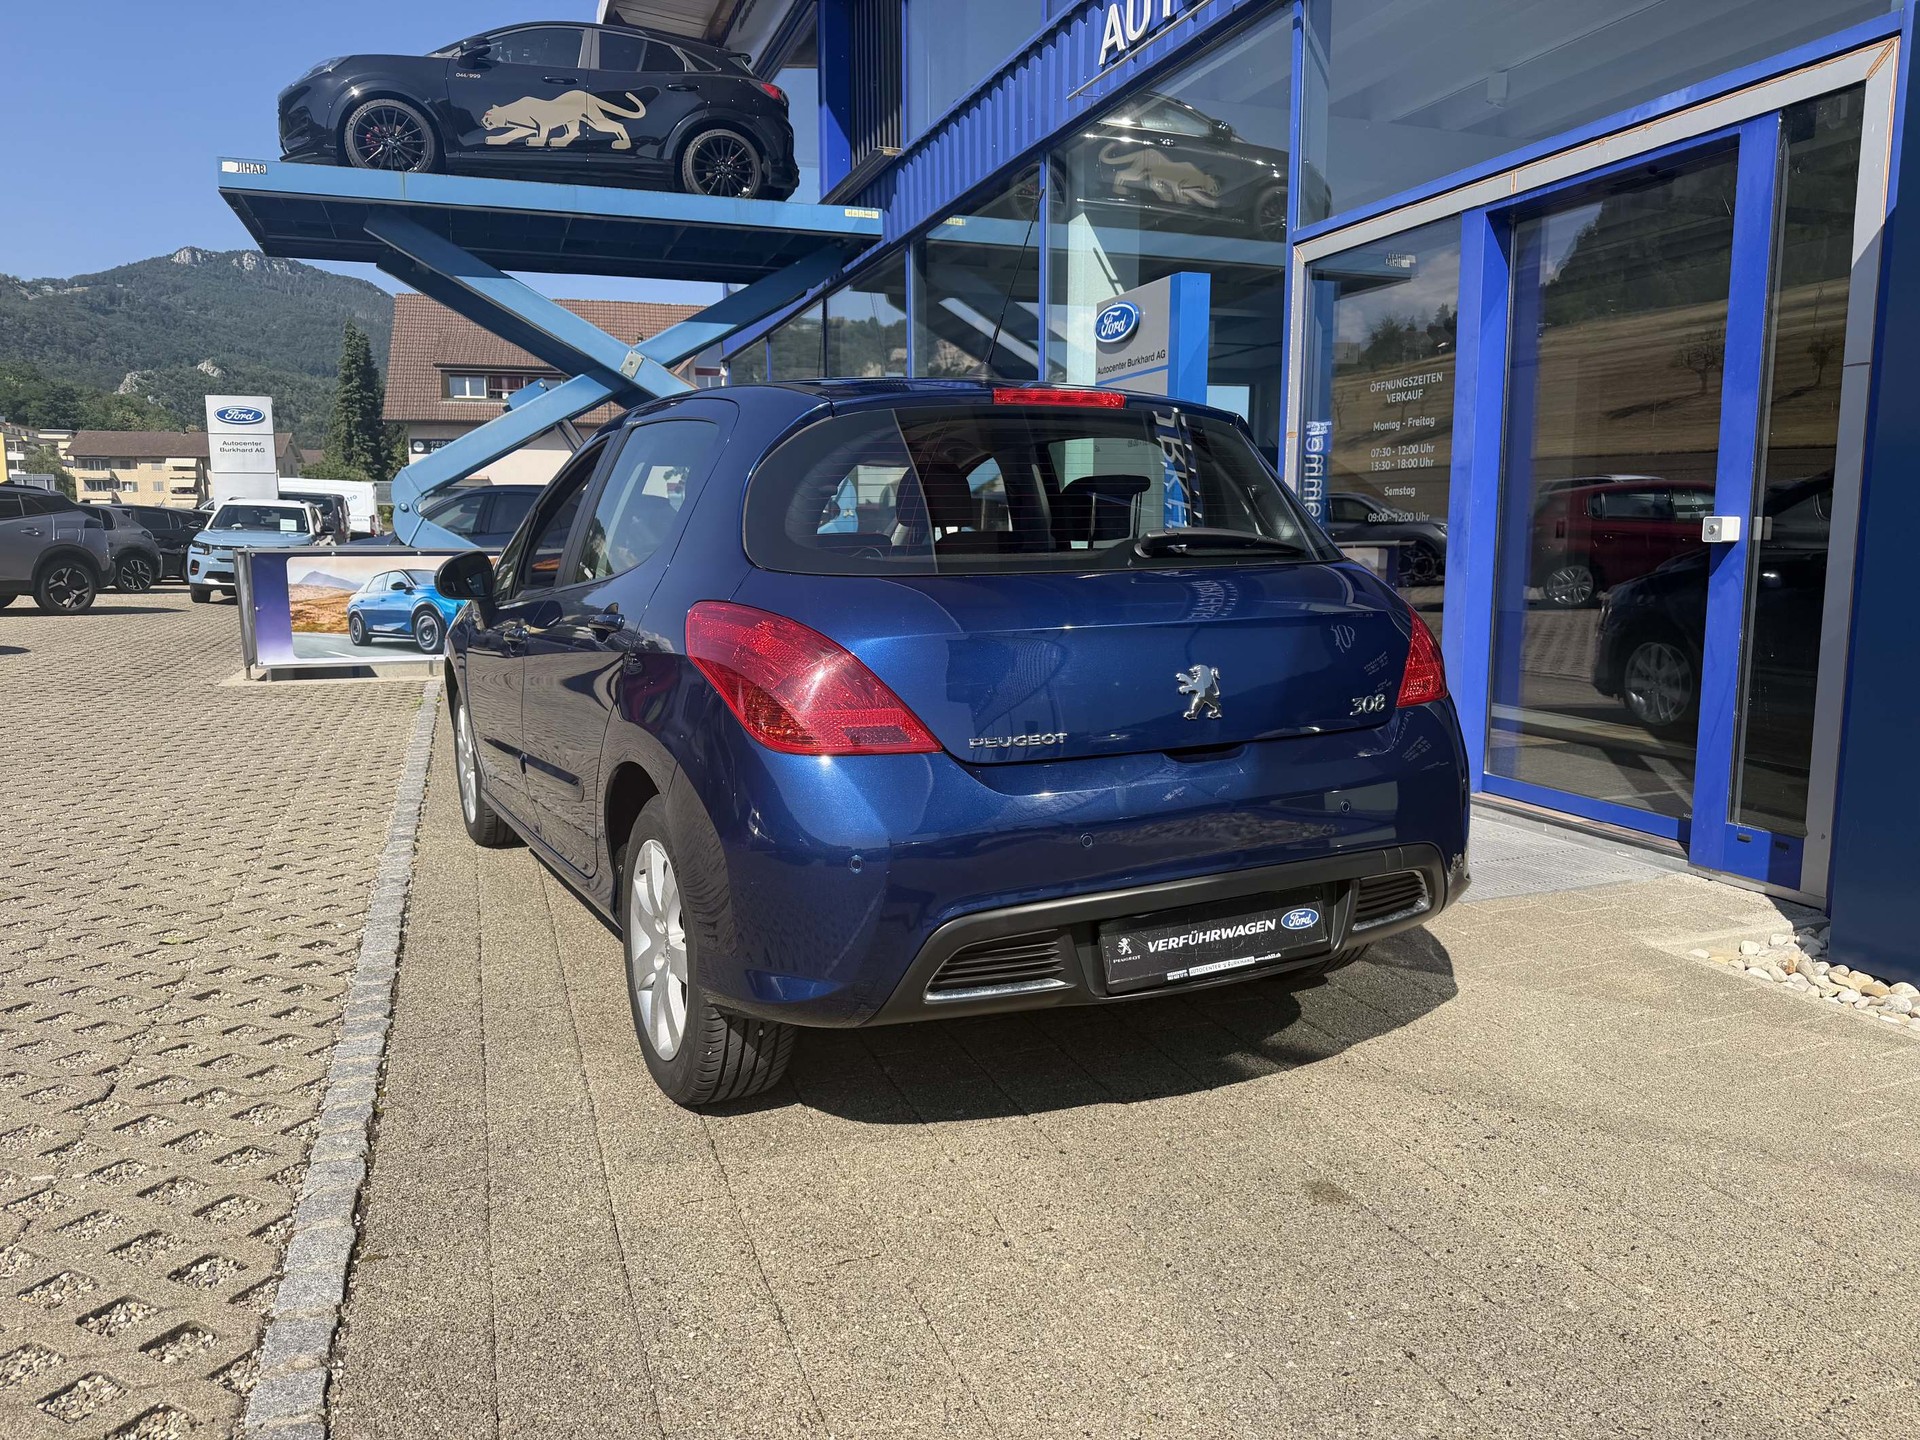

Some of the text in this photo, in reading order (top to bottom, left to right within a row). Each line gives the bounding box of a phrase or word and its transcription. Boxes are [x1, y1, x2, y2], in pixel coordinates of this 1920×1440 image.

[1098, 0, 1171, 67] AU
[236, 161, 266, 174] JIHAB
[1101, 310, 1127, 337] Ford
[1097, 349, 1166, 375] Autocenter Burkhard AG
[1370, 372, 1443, 393] ÖFFNUNGSZEITEN
[1386, 389, 1424, 403] VERKAUF
[1373, 421, 1400, 432] Montag
[1407, 416, 1435, 427] Freitag
[1370, 447, 1391, 458] 07:30
[1398, 444, 1419, 456] 12:00
[1420, 443, 1435, 454] Uhr
[1371, 460, 1391, 471] 13:30
[1397, 458, 1418, 469] 18:00
[1419, 457, 1434, 467] Uhr
[1384, 486, 1416, 497] Samstag
[1367, 513, 1388, 523] 09:00
[1394, 512, 1415, 522] 12:00
[1415, 511, 1430, 522] Uhr
[1350, 693, 1386, 716] 308
[969, 731, 1068, 749] PEUGEOT
[1147, 918, 1276, 953] VERFÜHRWAGEN
[1113, 954, 1141, 963] PEUGEOT
[1190, 963, 1222, 975] AUTOCENTER
